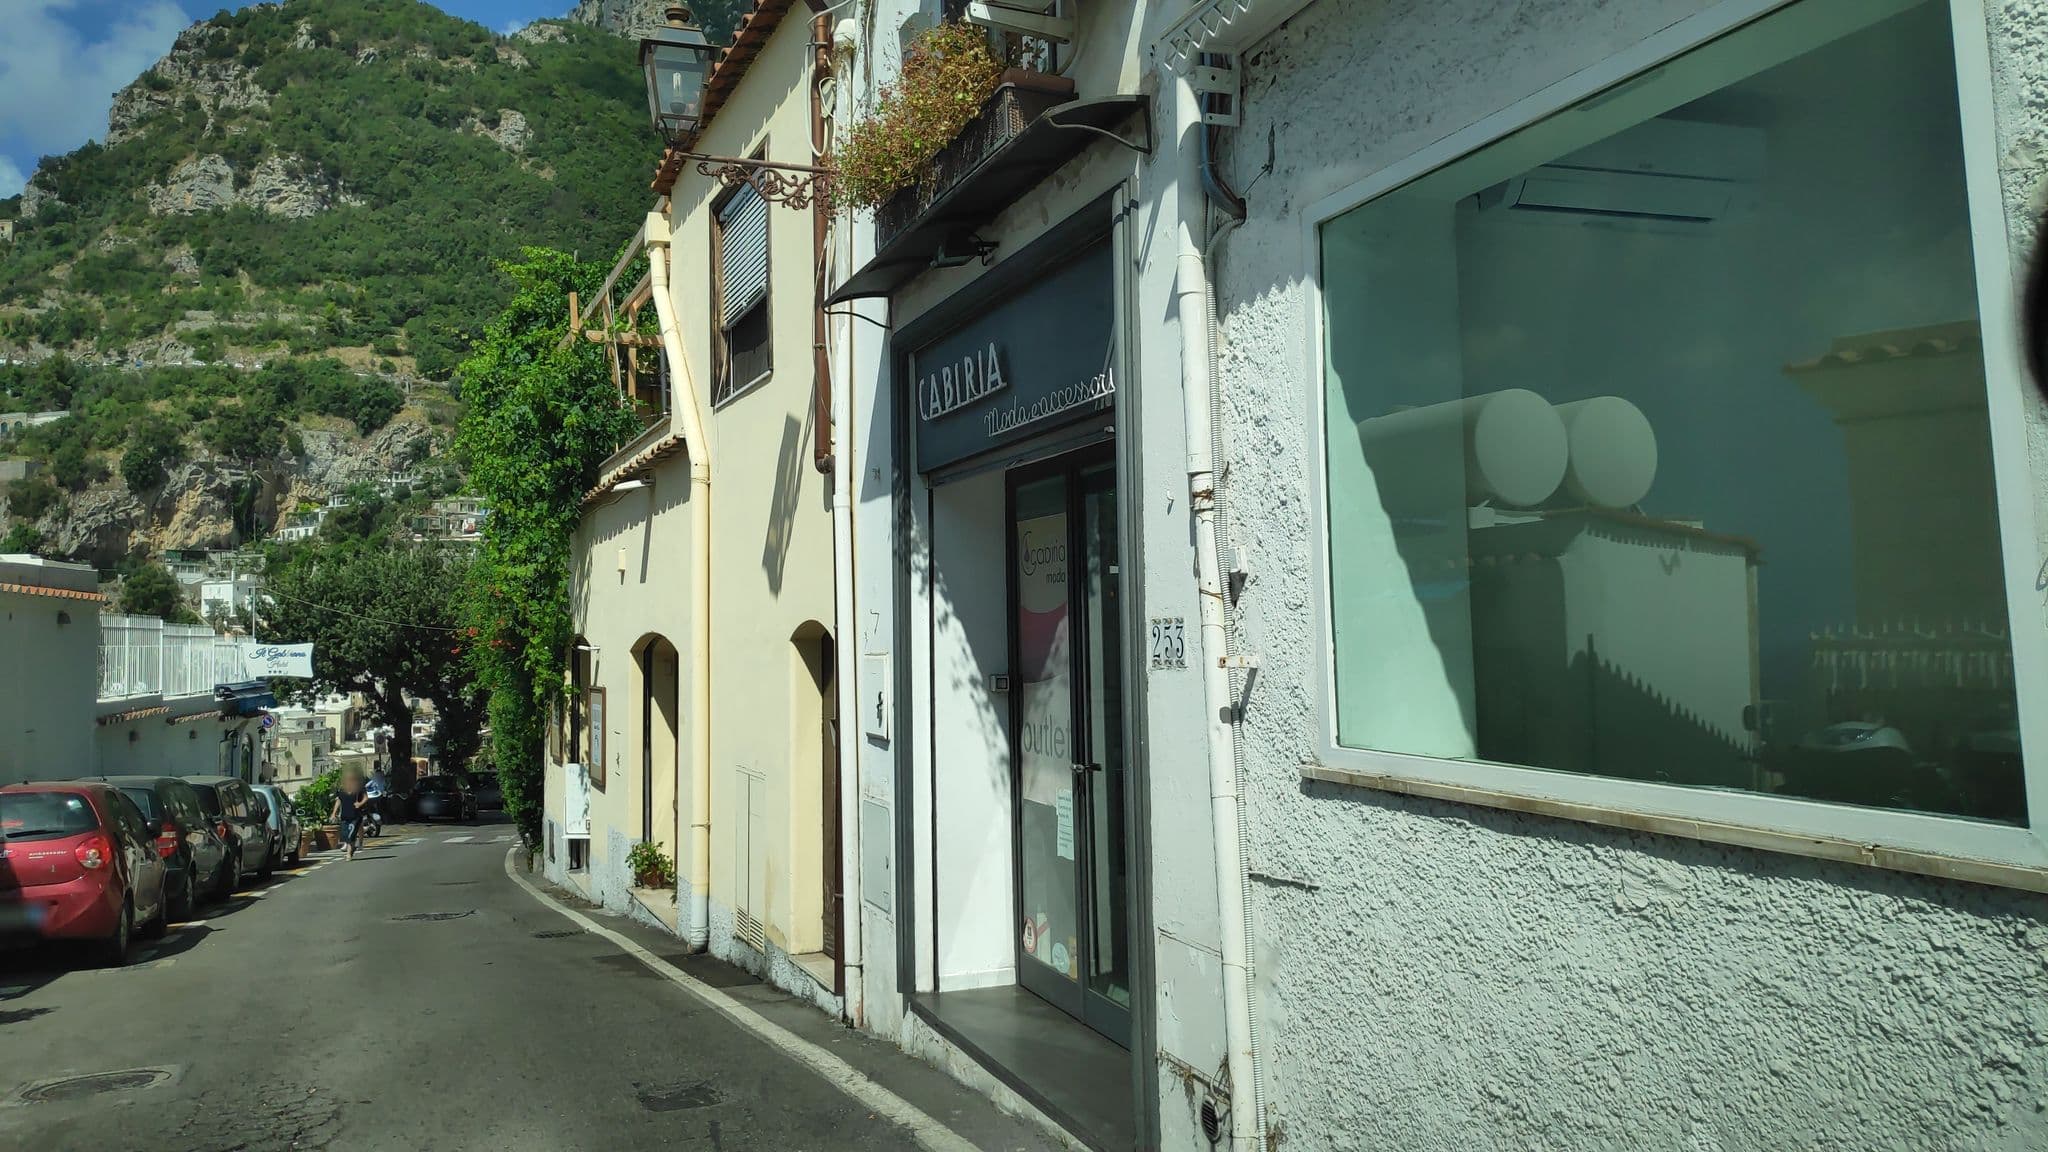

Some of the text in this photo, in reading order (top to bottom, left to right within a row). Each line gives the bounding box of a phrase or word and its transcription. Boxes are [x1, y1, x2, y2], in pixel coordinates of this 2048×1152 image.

[918, 341, 1007, 421] CABIRIA
[983, 395, 1031, 437] Moda
[1151, 625, 1184, 659] 253
[1023, 713, 1071, 760] outlet
